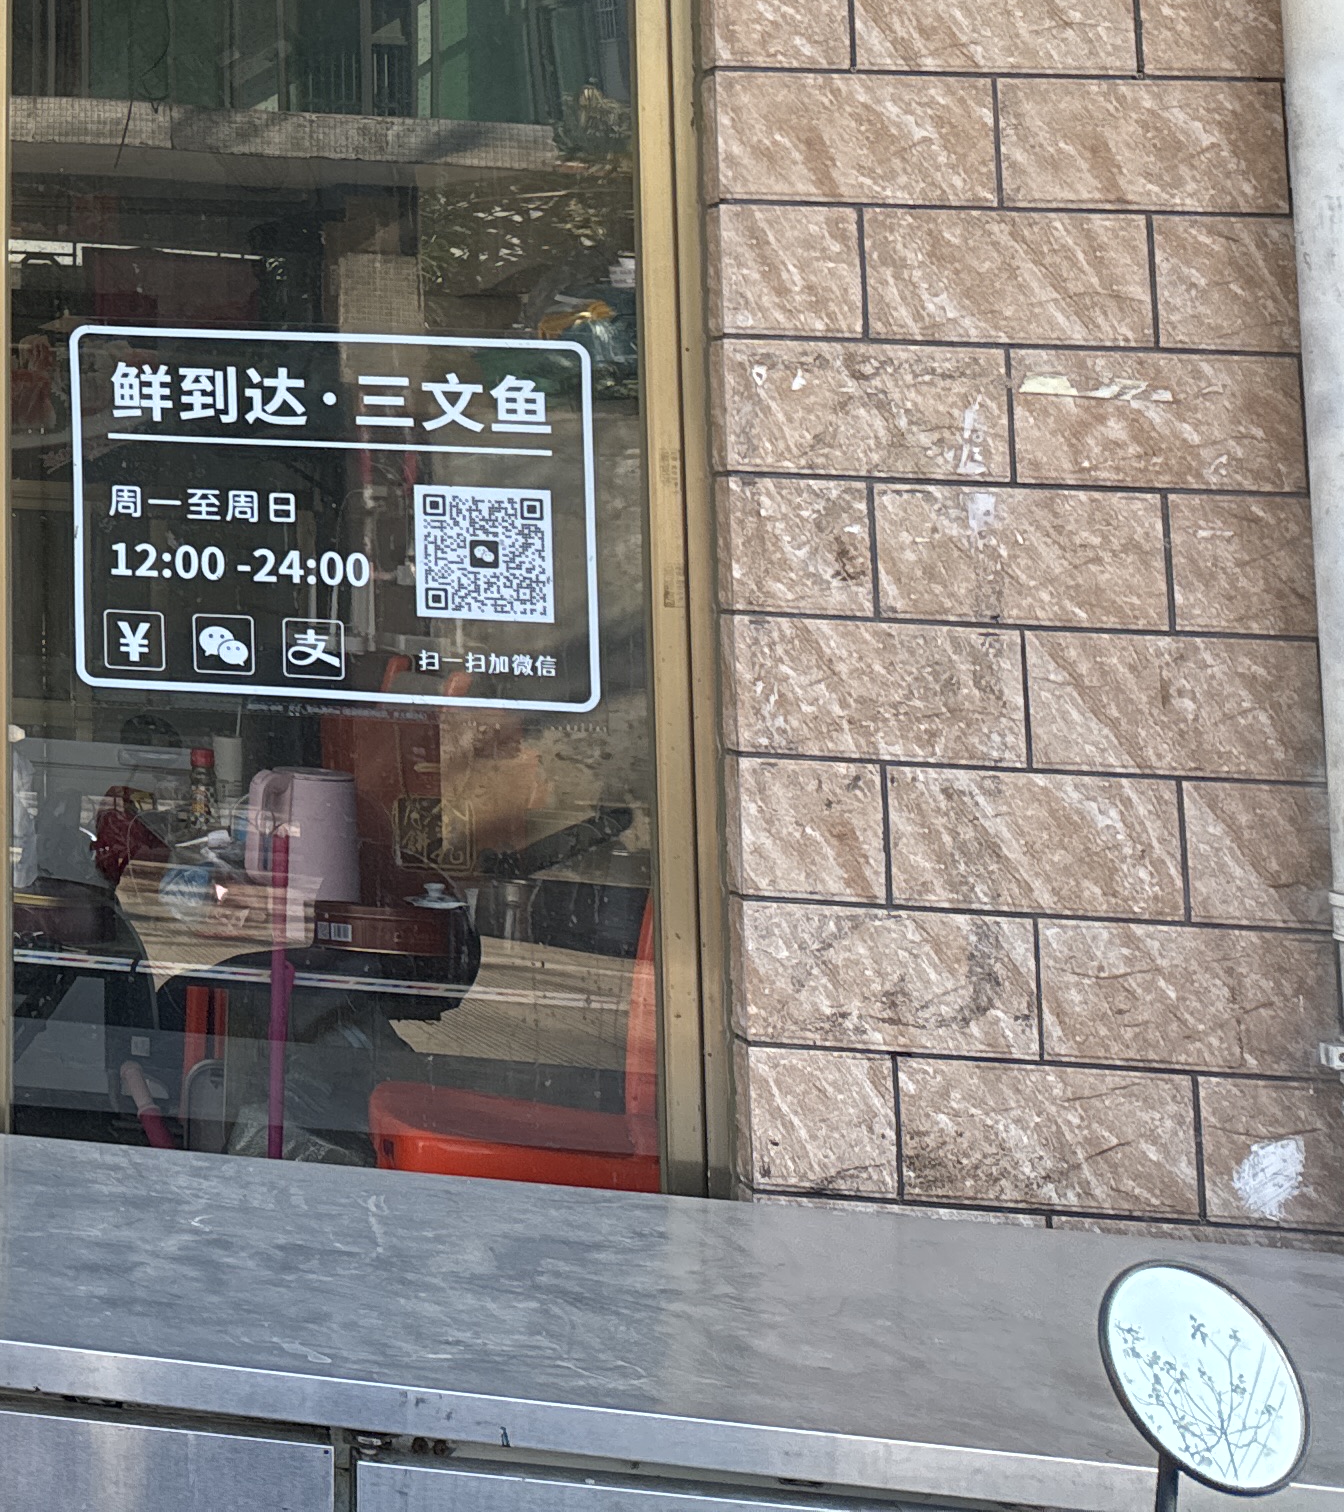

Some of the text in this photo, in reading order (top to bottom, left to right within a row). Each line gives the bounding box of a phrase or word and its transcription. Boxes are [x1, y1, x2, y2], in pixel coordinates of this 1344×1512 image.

[110, 361, 552, 434] 鲜到达·三文鱼
[109, 484, 298, 524] 周一至周日
[110, 541, 226, 581] 12:00
[418, 649, 557, 678] 扫一扫加微信
